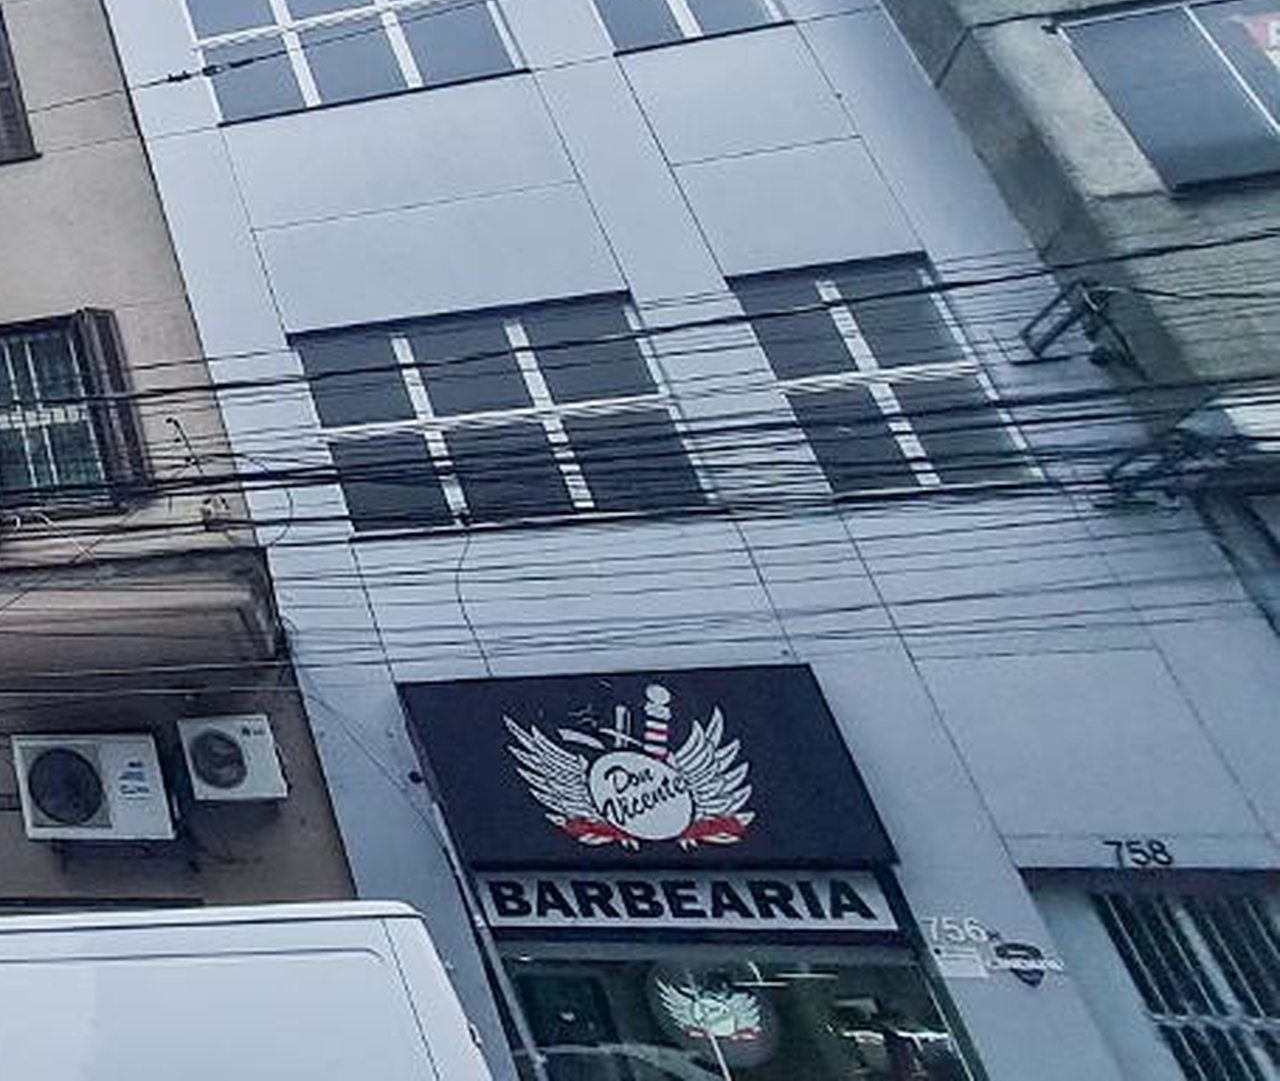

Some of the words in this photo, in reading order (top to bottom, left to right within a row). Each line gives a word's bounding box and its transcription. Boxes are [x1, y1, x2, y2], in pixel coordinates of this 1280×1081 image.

[604, 765, 654, 795] Don
[602, 773, 688, 826] Vicente
[1102, 839, 1174, 868] 758
[487, 879, 877, 921] BARBEARIA
[919, 917, 989, 943] 756
